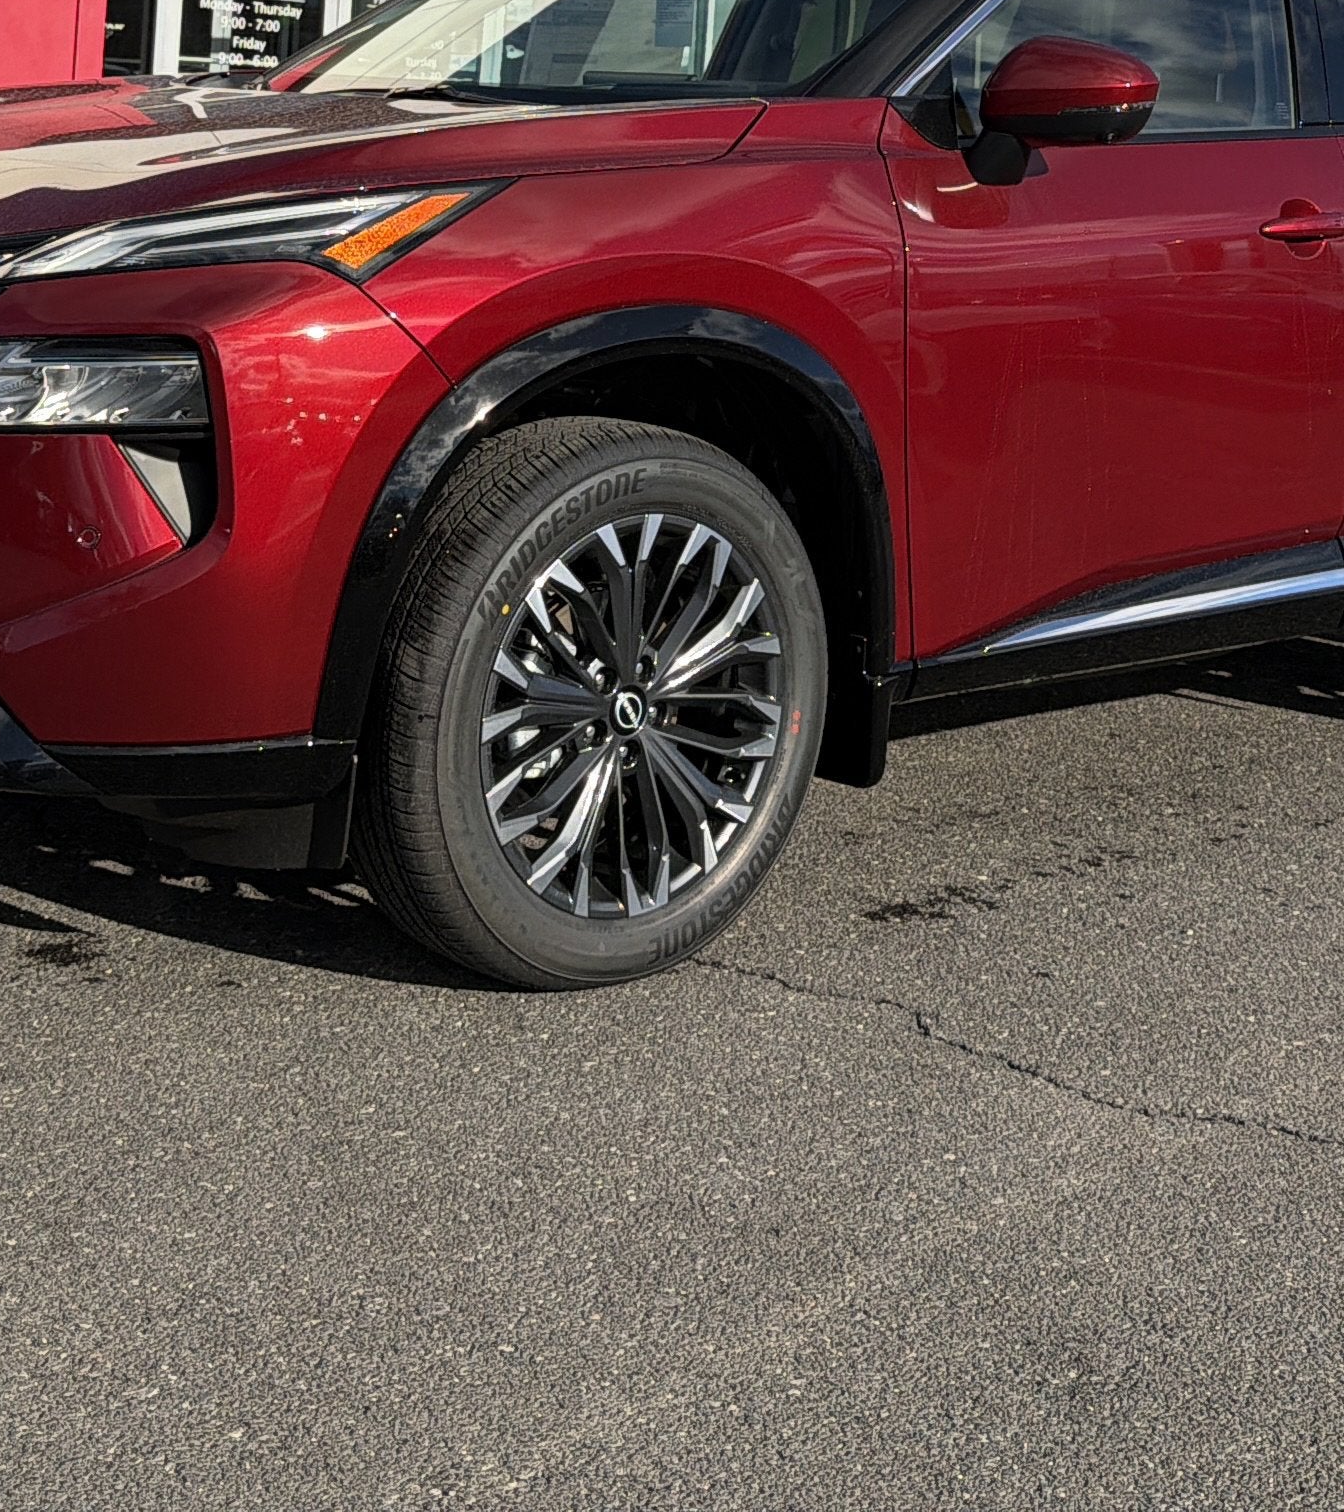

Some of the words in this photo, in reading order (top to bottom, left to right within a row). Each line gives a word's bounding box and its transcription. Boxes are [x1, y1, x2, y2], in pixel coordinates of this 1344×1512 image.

[253, 1, 303, 20] Thursday
[221, 16, 246, 30] 9:00
[256, 18, 280, 32] 7:00
[233, 36, 266, 52] Friday
[219, 52, 244, 66] 9:00
[477, 467, 648, 628] BRIDGESTONE
[647, 792, 794, 967] BRIDGESTONE
